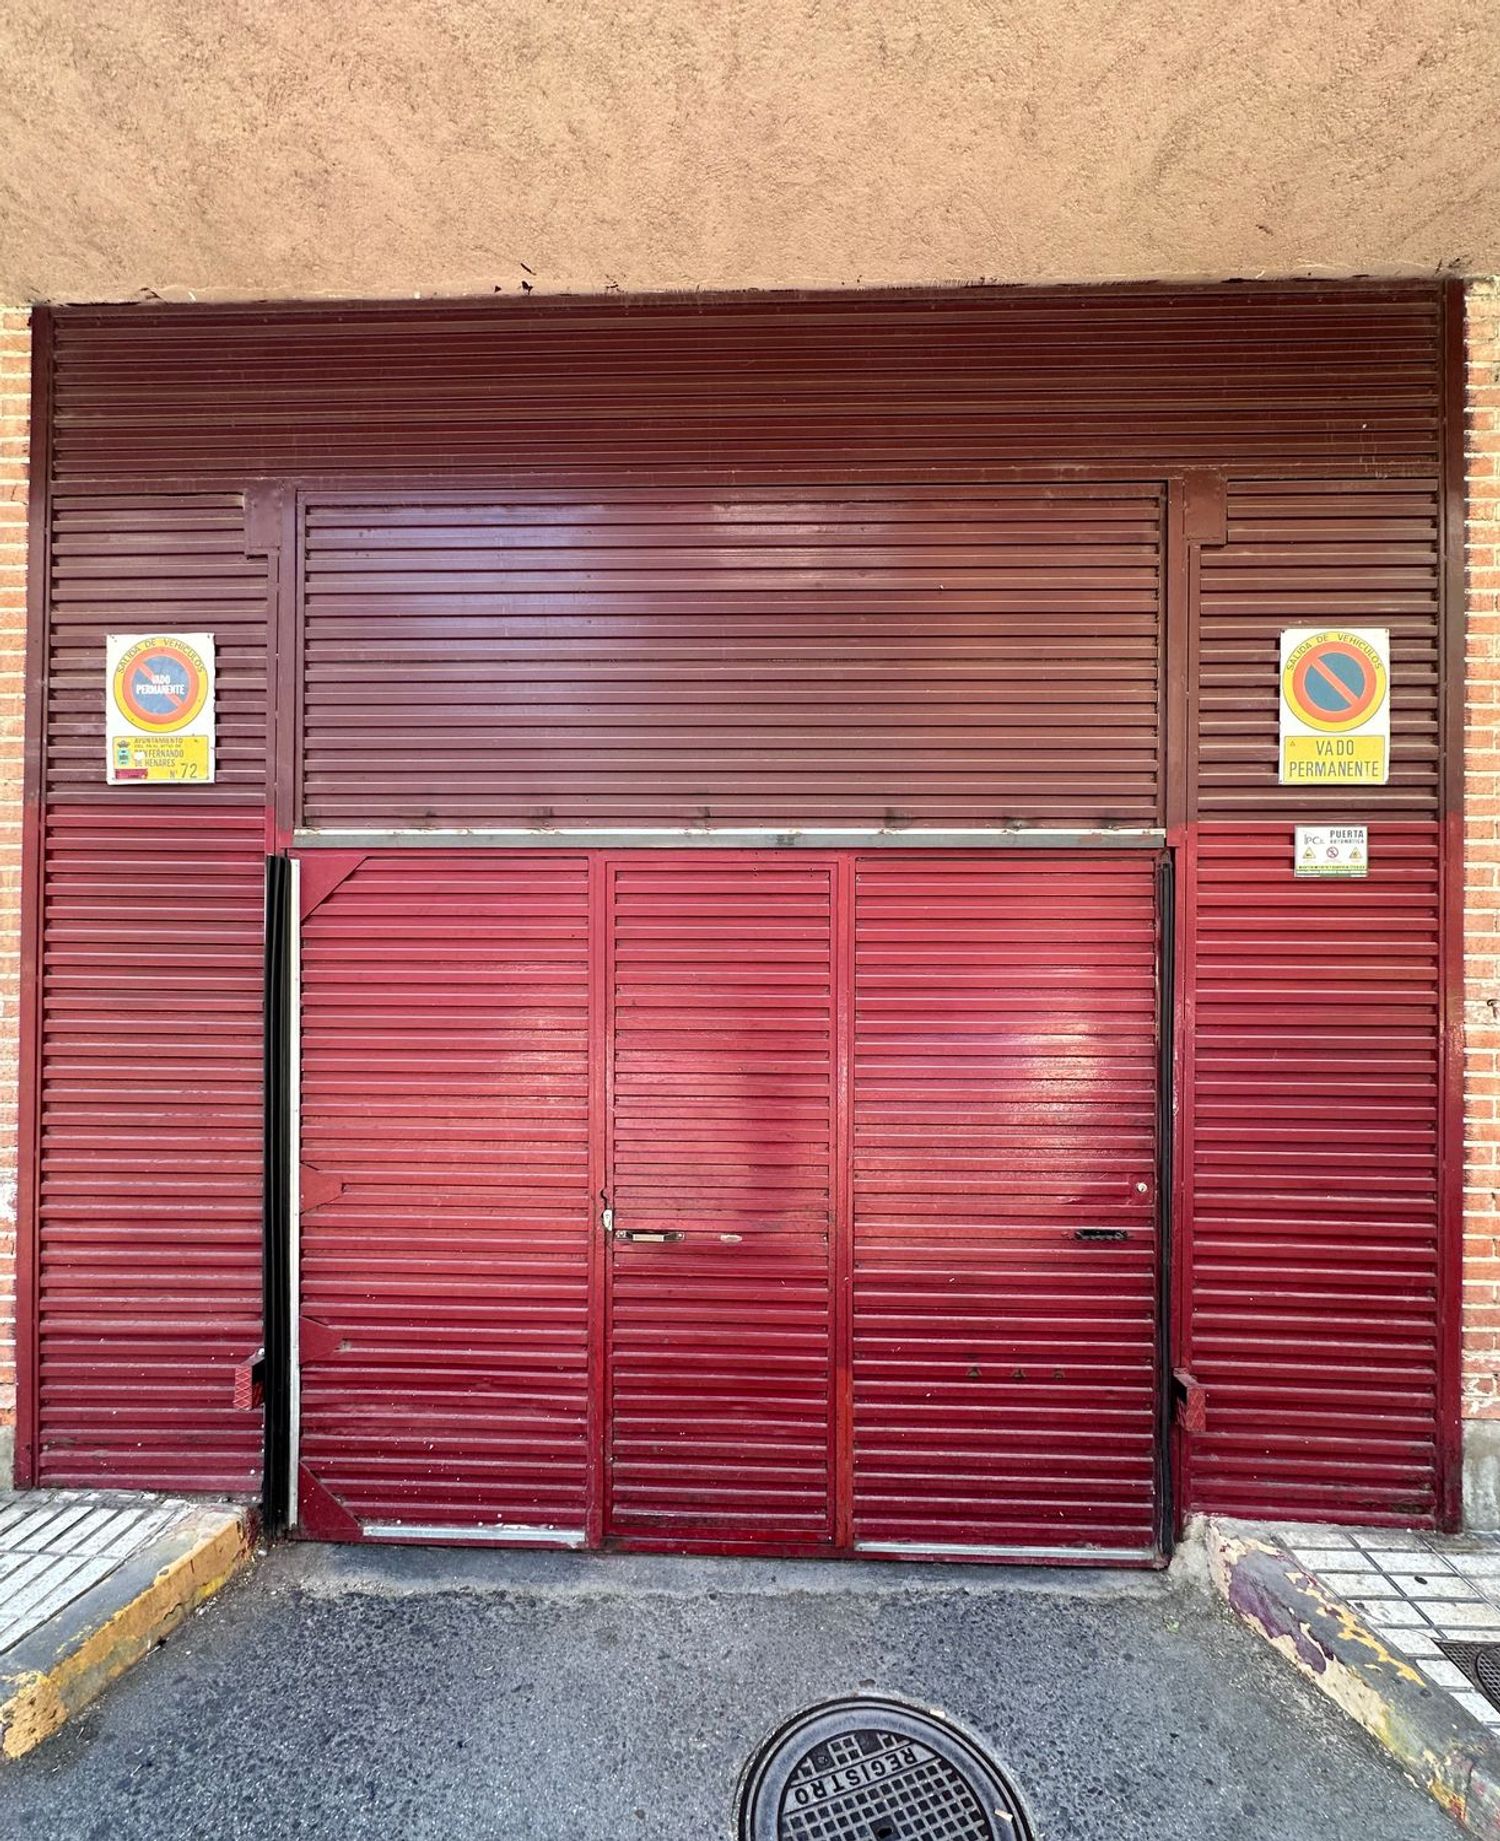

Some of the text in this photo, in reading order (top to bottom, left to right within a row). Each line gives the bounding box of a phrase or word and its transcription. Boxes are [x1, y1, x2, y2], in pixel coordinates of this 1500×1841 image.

[118, 645, 141, 674] SALIDA
[144, 638, 156, 648] DE
[1286, 642, 1312, 671] SALIDA
[1316, 634, 1329, 643] DE
[148, 749, 184, 758] FERNANDO
[1315, 740, 1354, 756] VADO
[144, 759, 176, 767] HENARES
[180, 763, 198, 779] 72
[1289, 760, 1379, 777] PERMANENTE
[1330, 829, 1364, 838] PUERTA
[794, 1746, 917, 1805] REGISTRO
